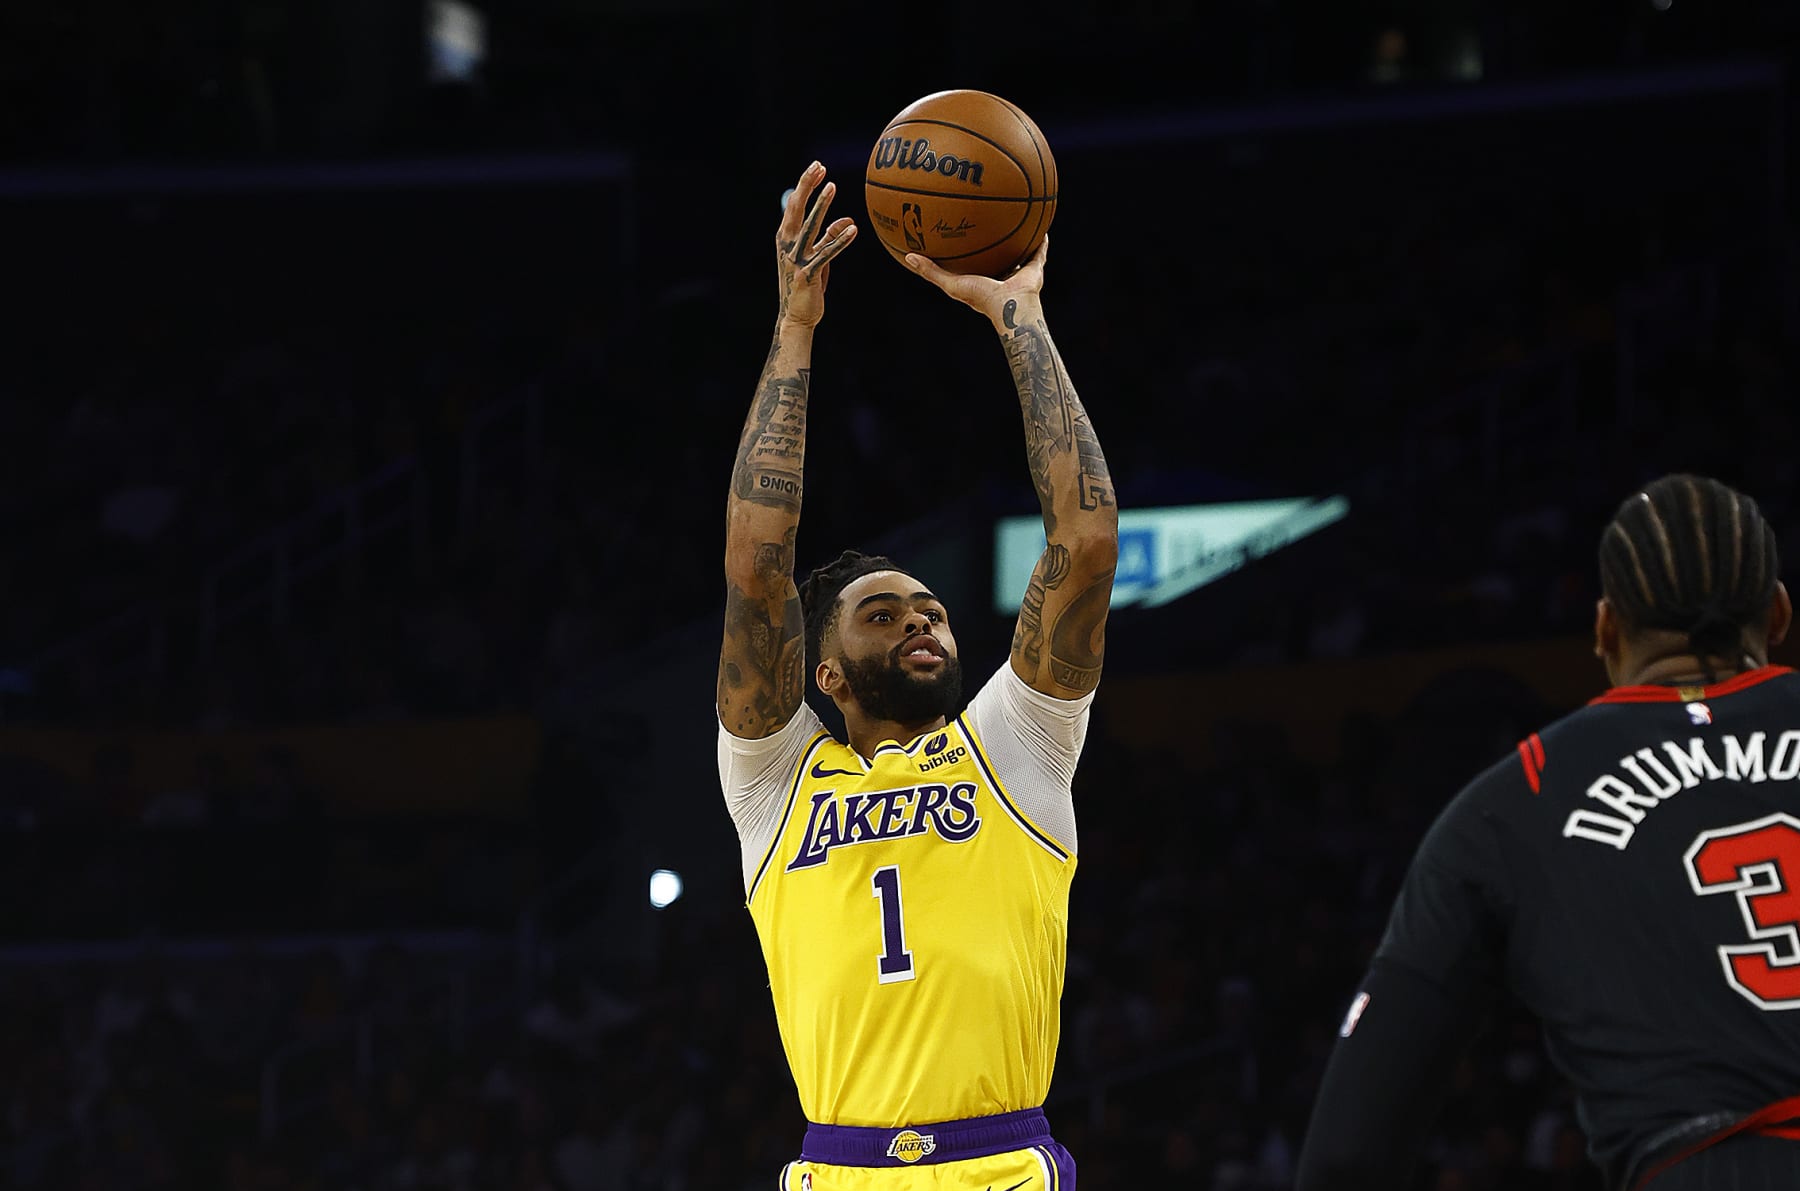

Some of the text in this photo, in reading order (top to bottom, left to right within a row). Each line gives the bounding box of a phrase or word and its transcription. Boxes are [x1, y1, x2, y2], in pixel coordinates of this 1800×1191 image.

[875, 136, 984, 187] Wilson
[760, 474, 803, 498] ADING
[918, 745, 967, 773] bibigo
[784, 781, 983, 874] LAKERS
[871, 864, 917, 985] 1
[1682, 812, 1800, 1011] 3
[887, 1139, 936, 1156] LAKERS
